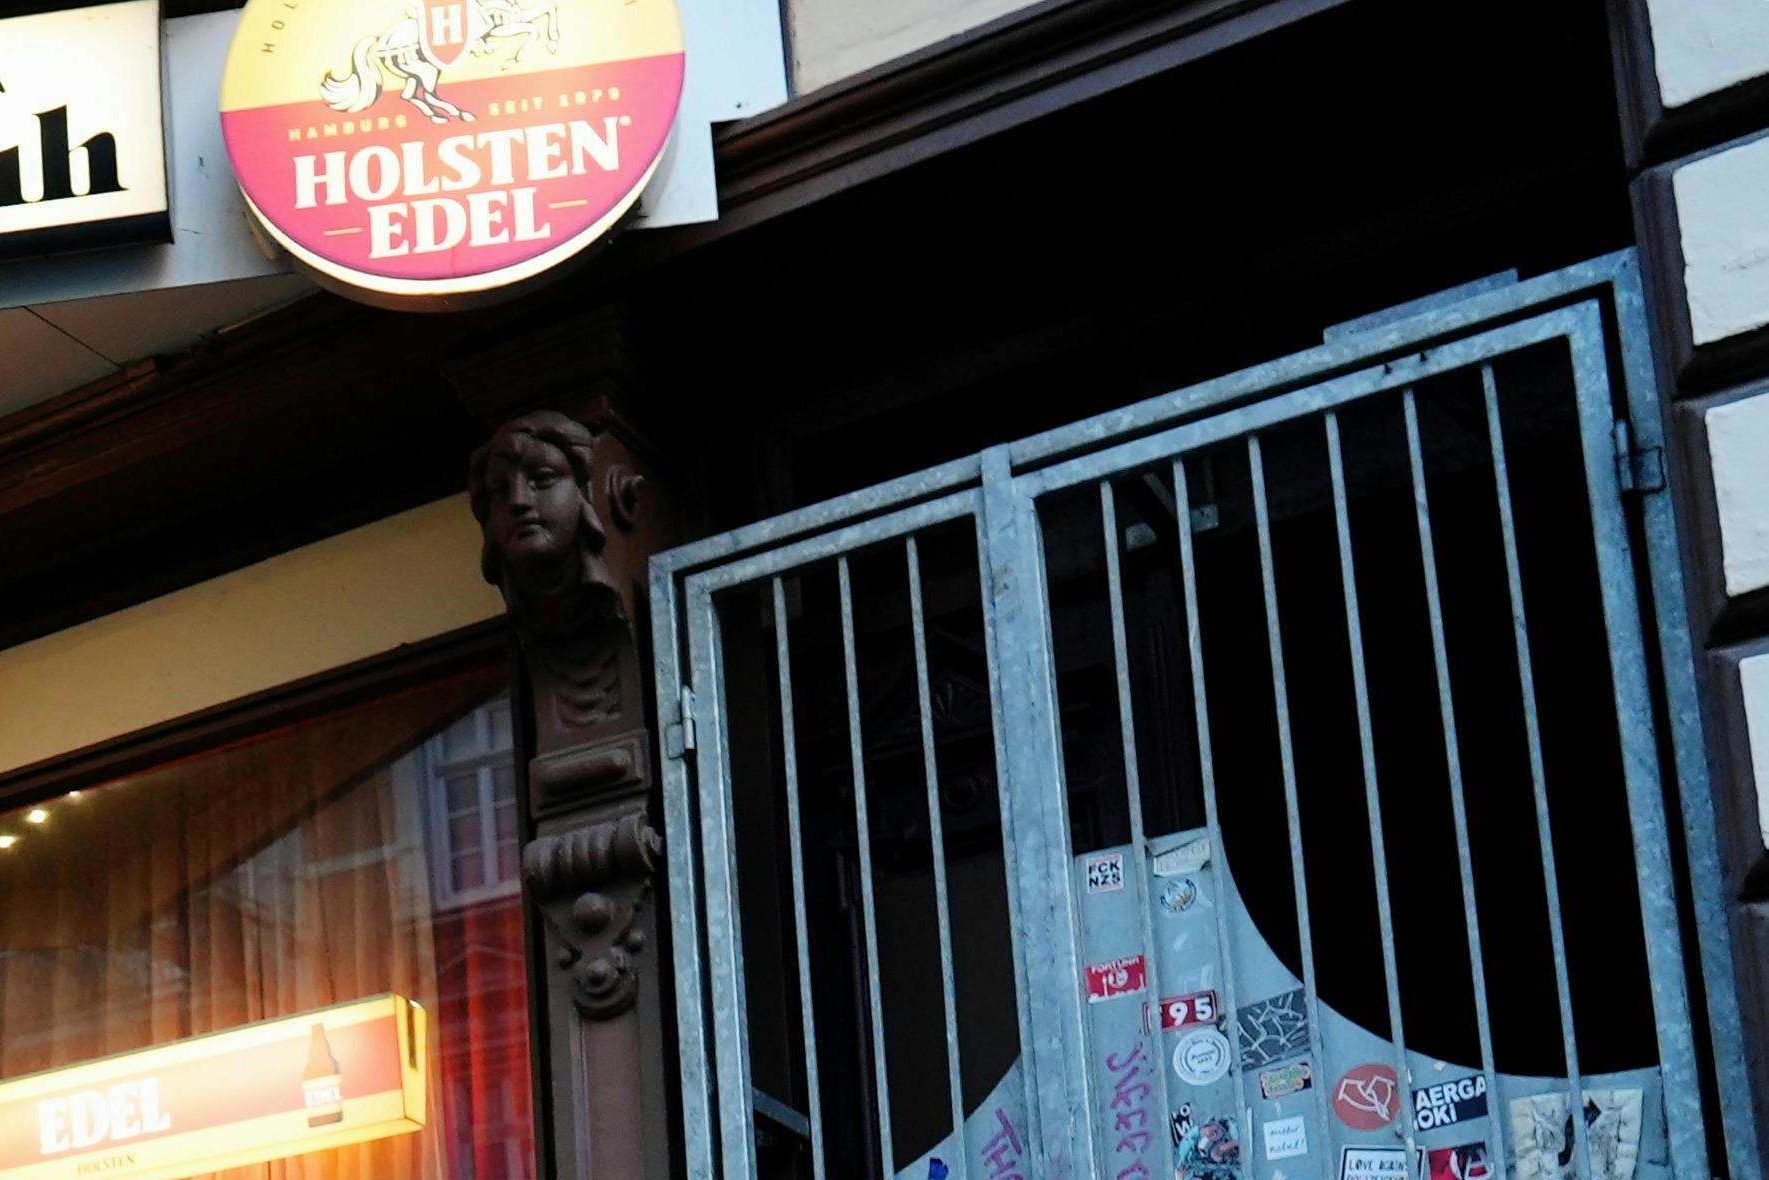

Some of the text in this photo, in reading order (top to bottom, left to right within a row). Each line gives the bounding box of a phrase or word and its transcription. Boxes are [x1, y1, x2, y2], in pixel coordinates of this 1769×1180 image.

[431, 4, 465, 46] H
[288, 113, 408, 141] HAMBURG
[488, 96, 544, 117] SEIT
[293, 116, 631, 209] HOLSTEN
[367, 187, 552, 260] EDEL
[1089, 860, 1120, 874] FCK
[1089, 873, 1120, 887] NZS
[38, 1077, 170, 1155] EDEL
